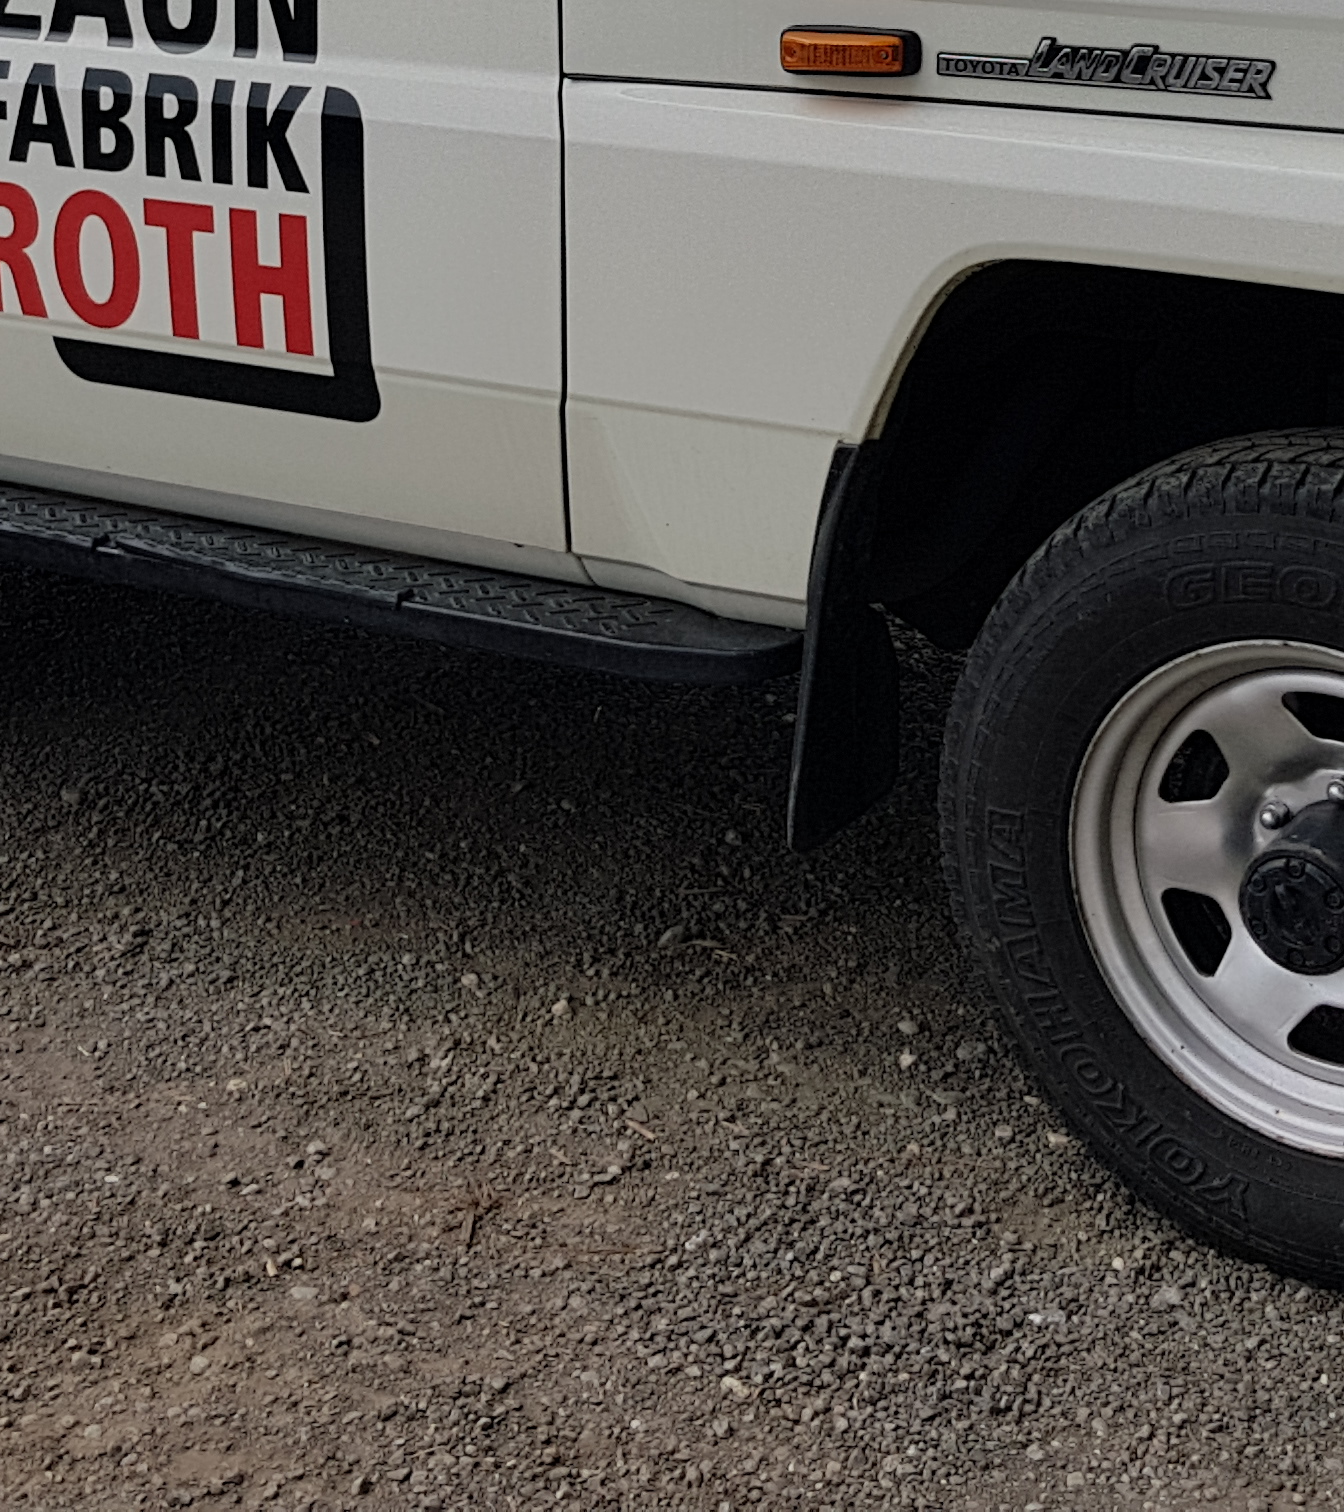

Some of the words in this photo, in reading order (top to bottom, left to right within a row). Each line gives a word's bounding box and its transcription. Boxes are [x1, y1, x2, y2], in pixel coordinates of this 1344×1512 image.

[943, 58, 1020, 76] TOYOTA
[1029, 37, 1122, 85] LAND
[1119, 44, 1276, 99] CRUISER
[981, 803, 1253, 1228] YOKOHAMA
